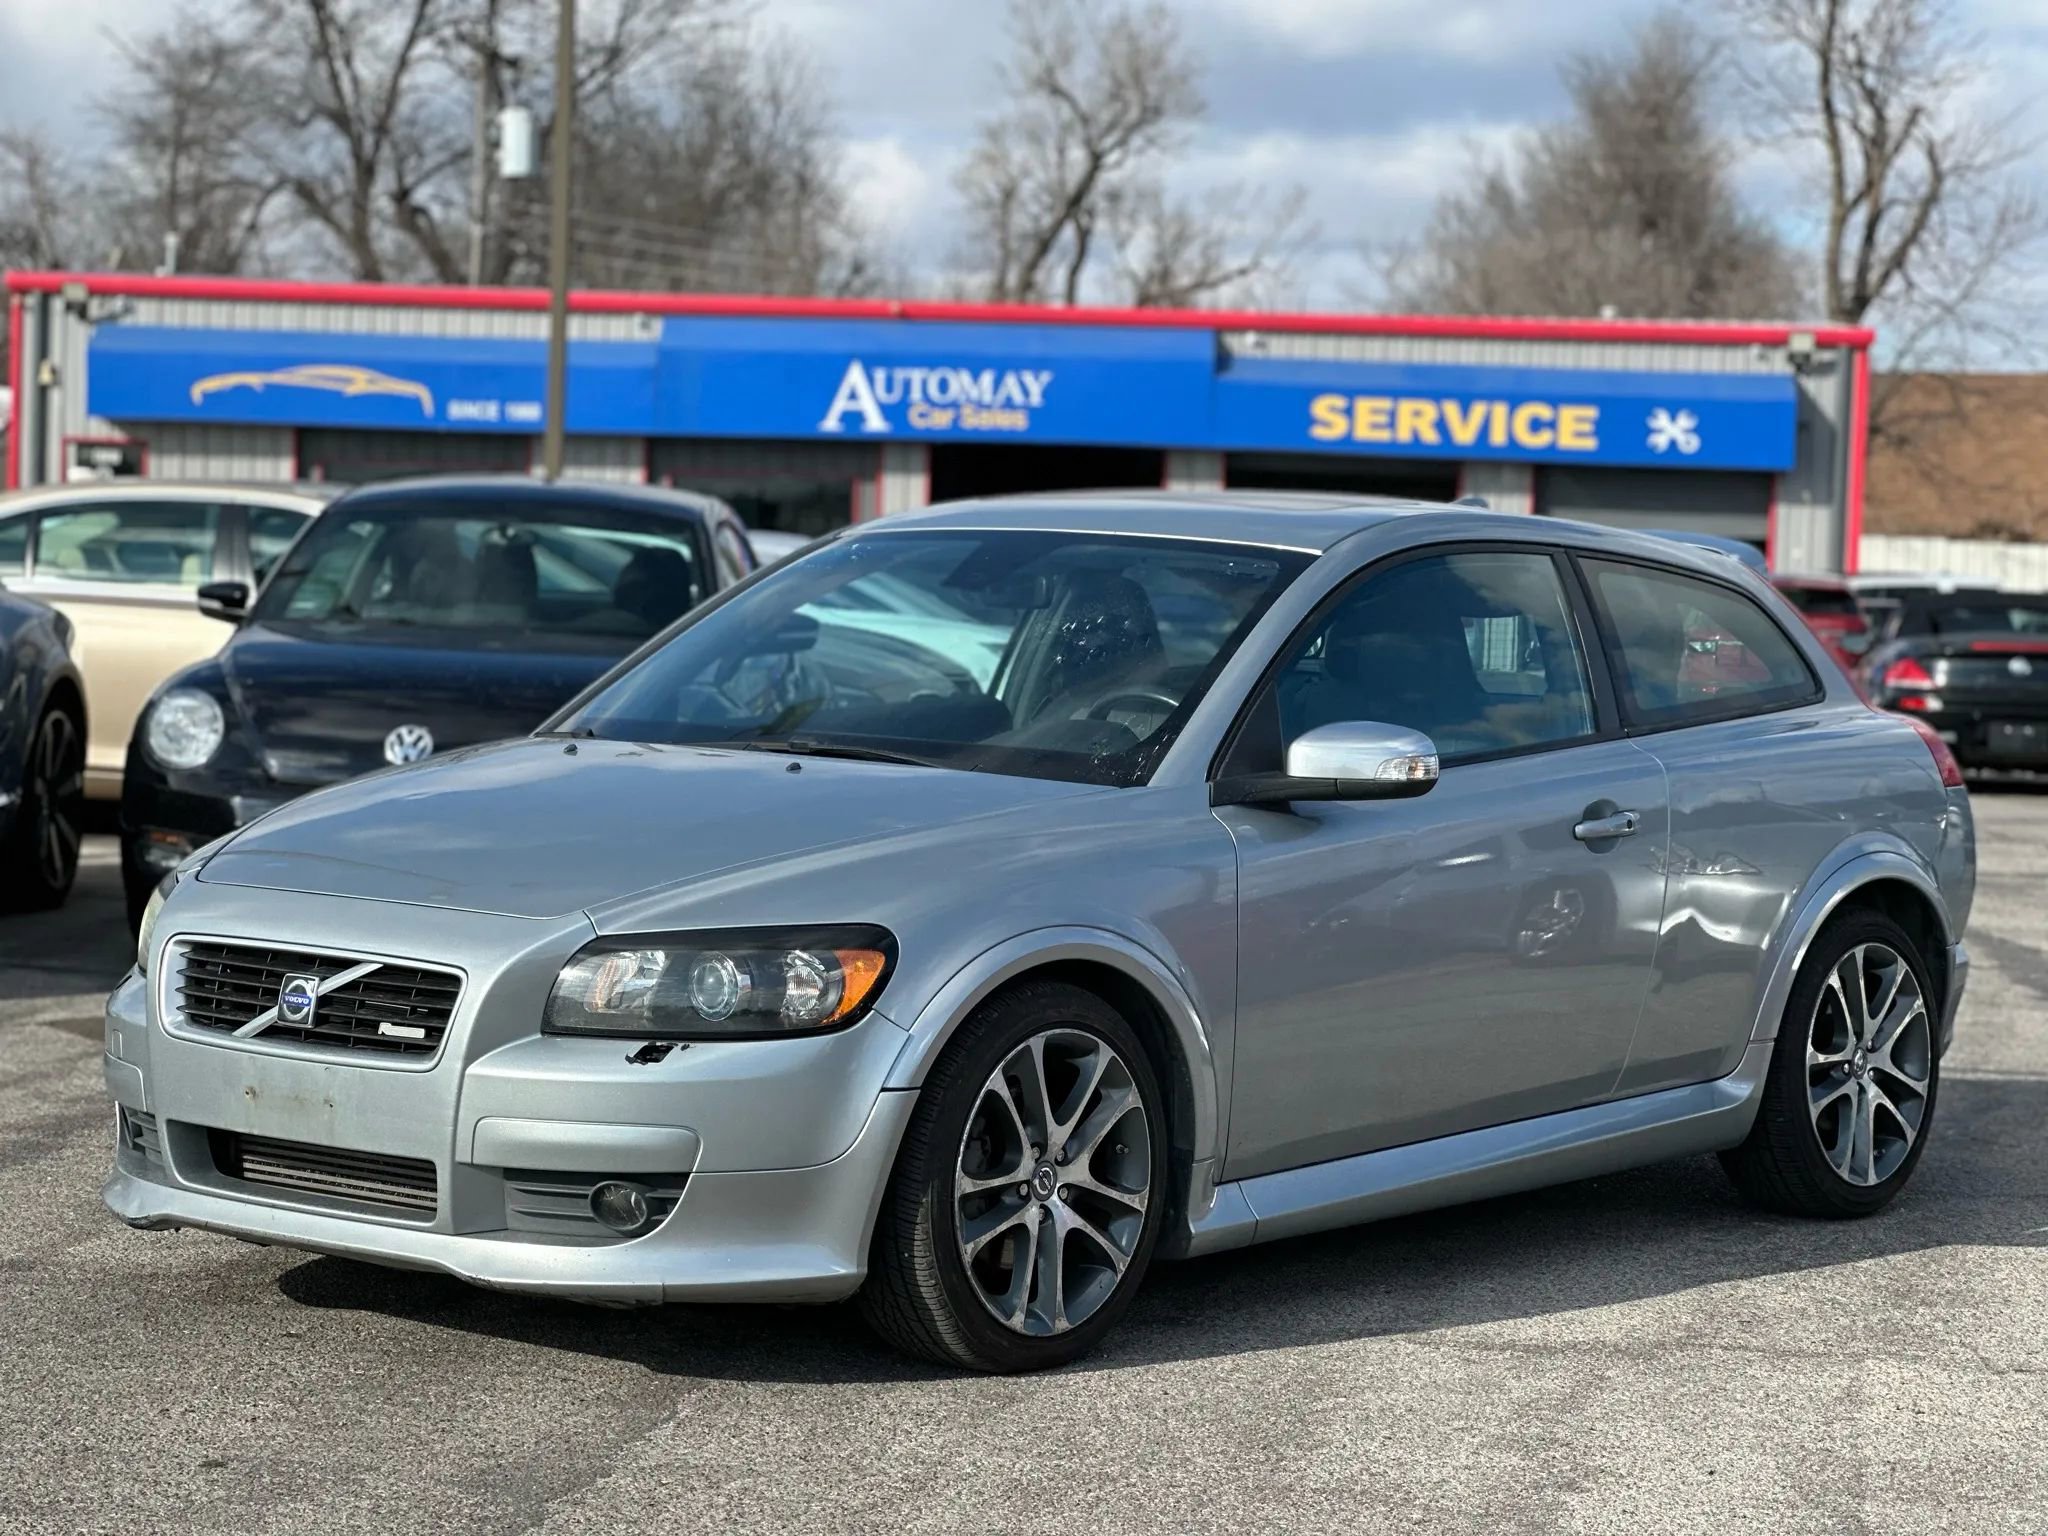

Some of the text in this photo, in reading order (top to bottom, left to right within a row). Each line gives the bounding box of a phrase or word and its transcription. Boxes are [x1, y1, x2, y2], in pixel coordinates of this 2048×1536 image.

[817, 359, 1054, 432] AUTOMAY
[907, 404, 1030, 432] Car Sales
[1308, 393, 1600, 451] SERVICE
[284, 995, 310, 1005] VOLVO
